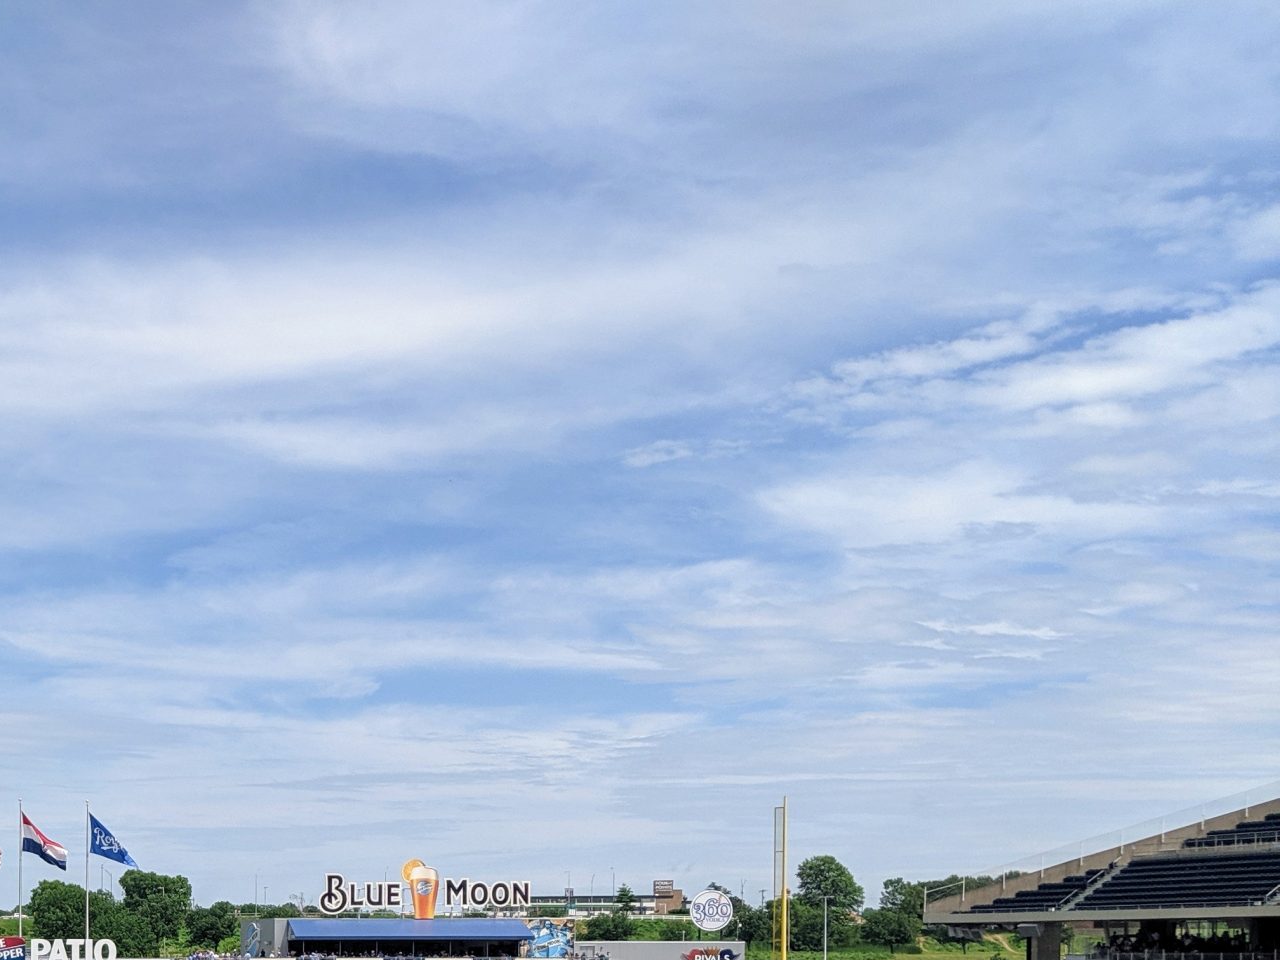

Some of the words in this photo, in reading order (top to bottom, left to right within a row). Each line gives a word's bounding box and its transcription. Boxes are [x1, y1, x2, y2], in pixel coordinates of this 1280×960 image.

[320, 874, 401, 914] BLUE
[445, 878, 531, 906] MOON
[694, 898, 731, 922] 360
